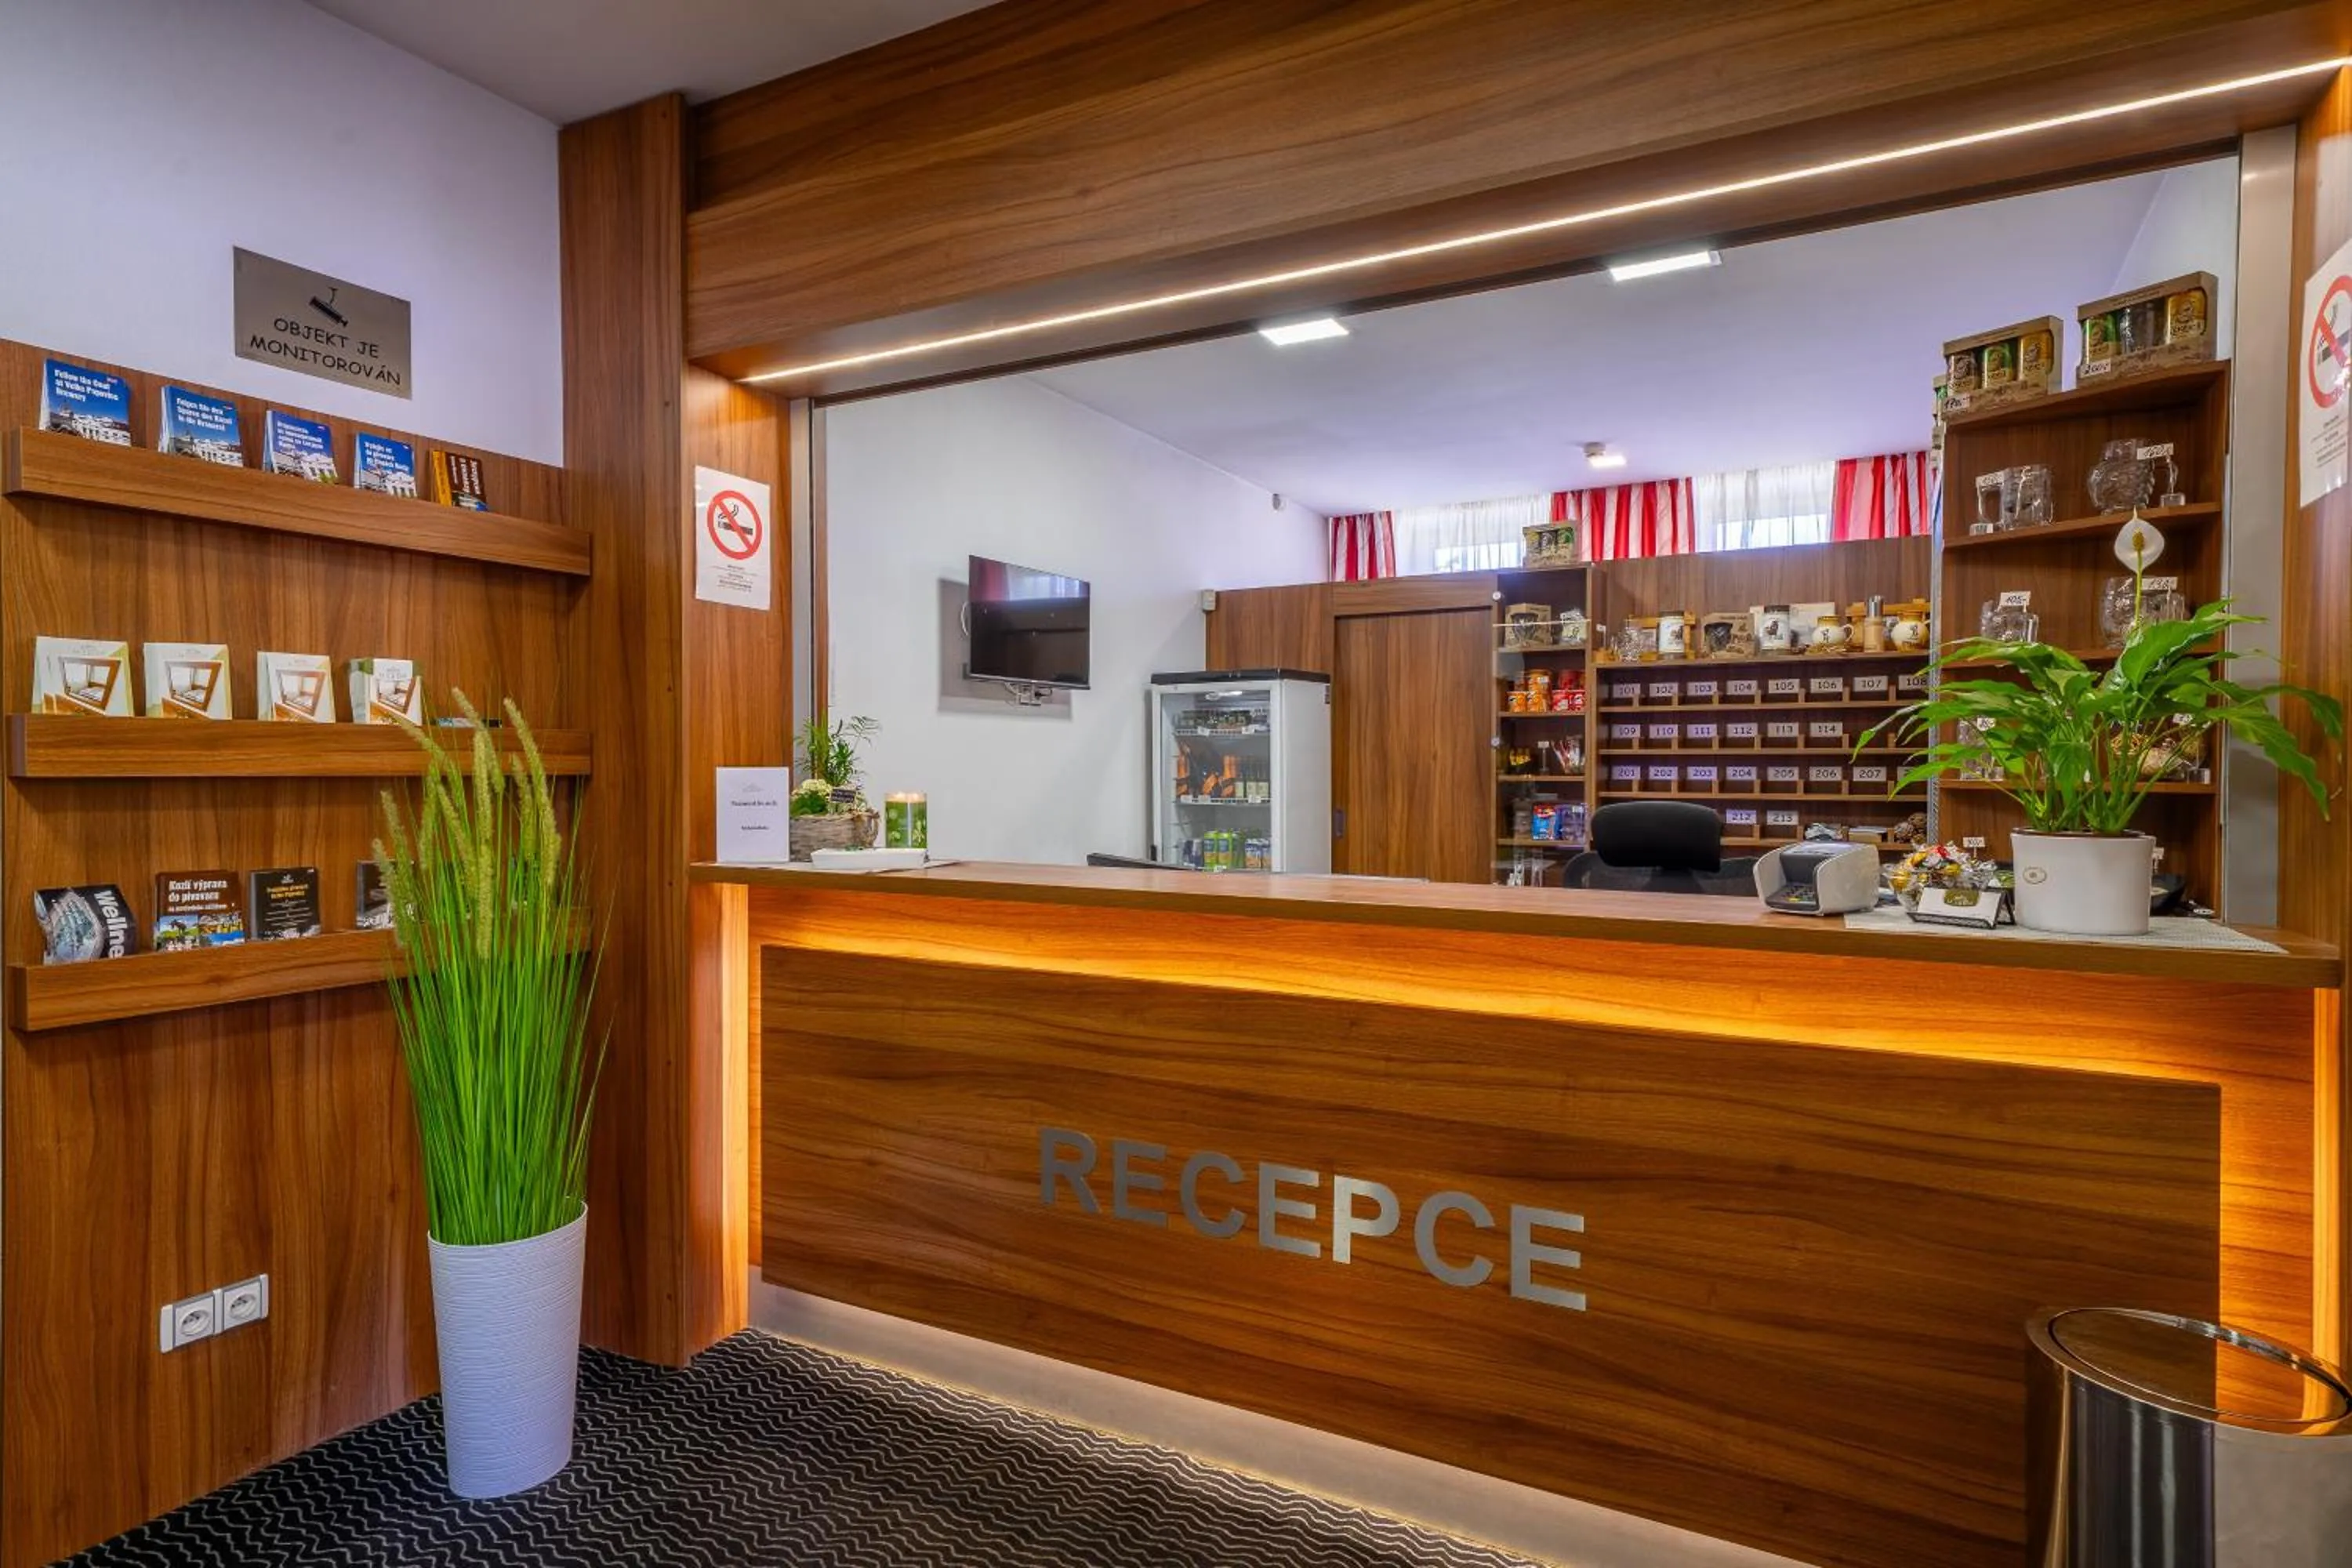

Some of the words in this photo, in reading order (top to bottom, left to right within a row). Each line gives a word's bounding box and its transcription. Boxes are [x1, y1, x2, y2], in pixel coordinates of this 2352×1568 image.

[274, 318, 350, 348] OBJEKT
[357, 341, 379, 358] JE
[249, 335, 401, 385] MONITOROVÁN
[1817, 681, 1837, 689] 106
[1861, 679, 1882, 688] 107
[1906, 676, 1927, 686] 108
[1734, 683, 1752, 691] 104
[1775, 682, 1795, 691] 105
[1818, 725, 1836, 734] 114
[1773, 769, 1795, 778] 205
[1815, 769, 1837, 778] 206
[1859, 769, 1882, 779] 207
[1732, 811, 1751, 821] 212
[1773, 814, 1793, 822] 213
[193, 880, 228, 891] výprava
[168, 891, 180, 902] do
[94, 890, 128, 959] Wellne
[1038, 1126, 1586, 1312] RECEPCE
